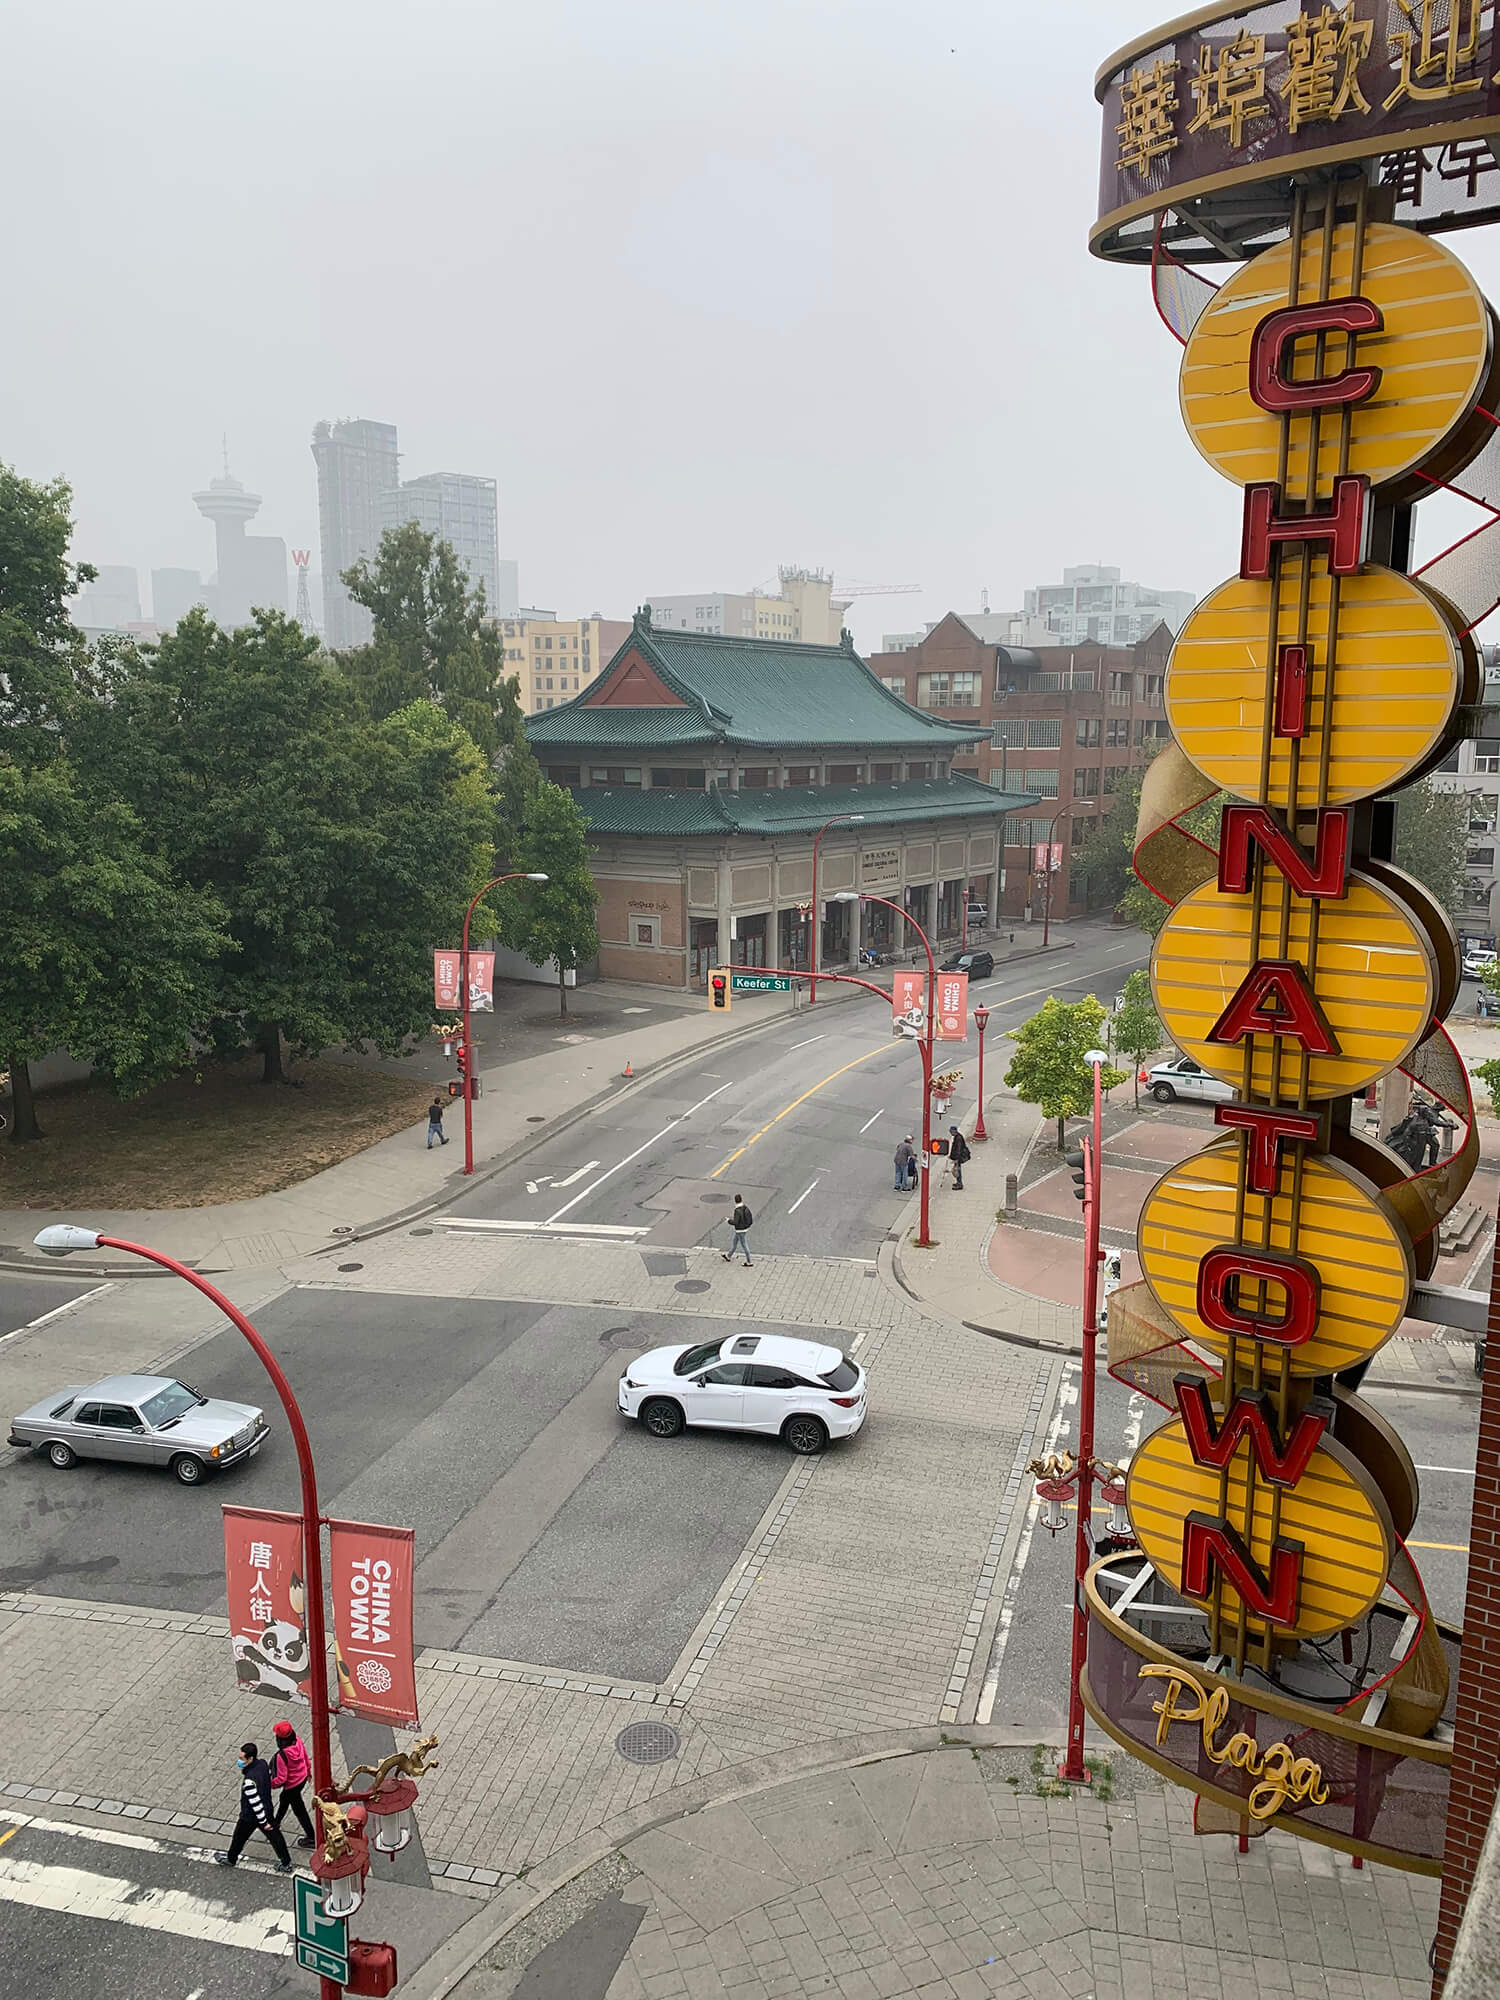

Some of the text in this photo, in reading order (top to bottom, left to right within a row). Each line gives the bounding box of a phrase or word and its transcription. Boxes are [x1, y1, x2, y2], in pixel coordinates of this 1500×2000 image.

[1114, 0, 1500, 178] 華埠歡迎
[291, 550, 311, 566] W
[737, 978, 785, 989] Keefer St
[943, 981, 952, 1011] TOWN
[951, 982, 960, 1012] CHINA
[1173, 296, 1385, 1630] CHINATOWN
[248, 1541, 273, 1624] 唐人街
[350, 1557, 371, 1643] TOWN
[371, 1559, 393, 1646] CHINA
[1138, 1662, 1331, 1821] Plaza
[305, 1891, 336, 1936] P
